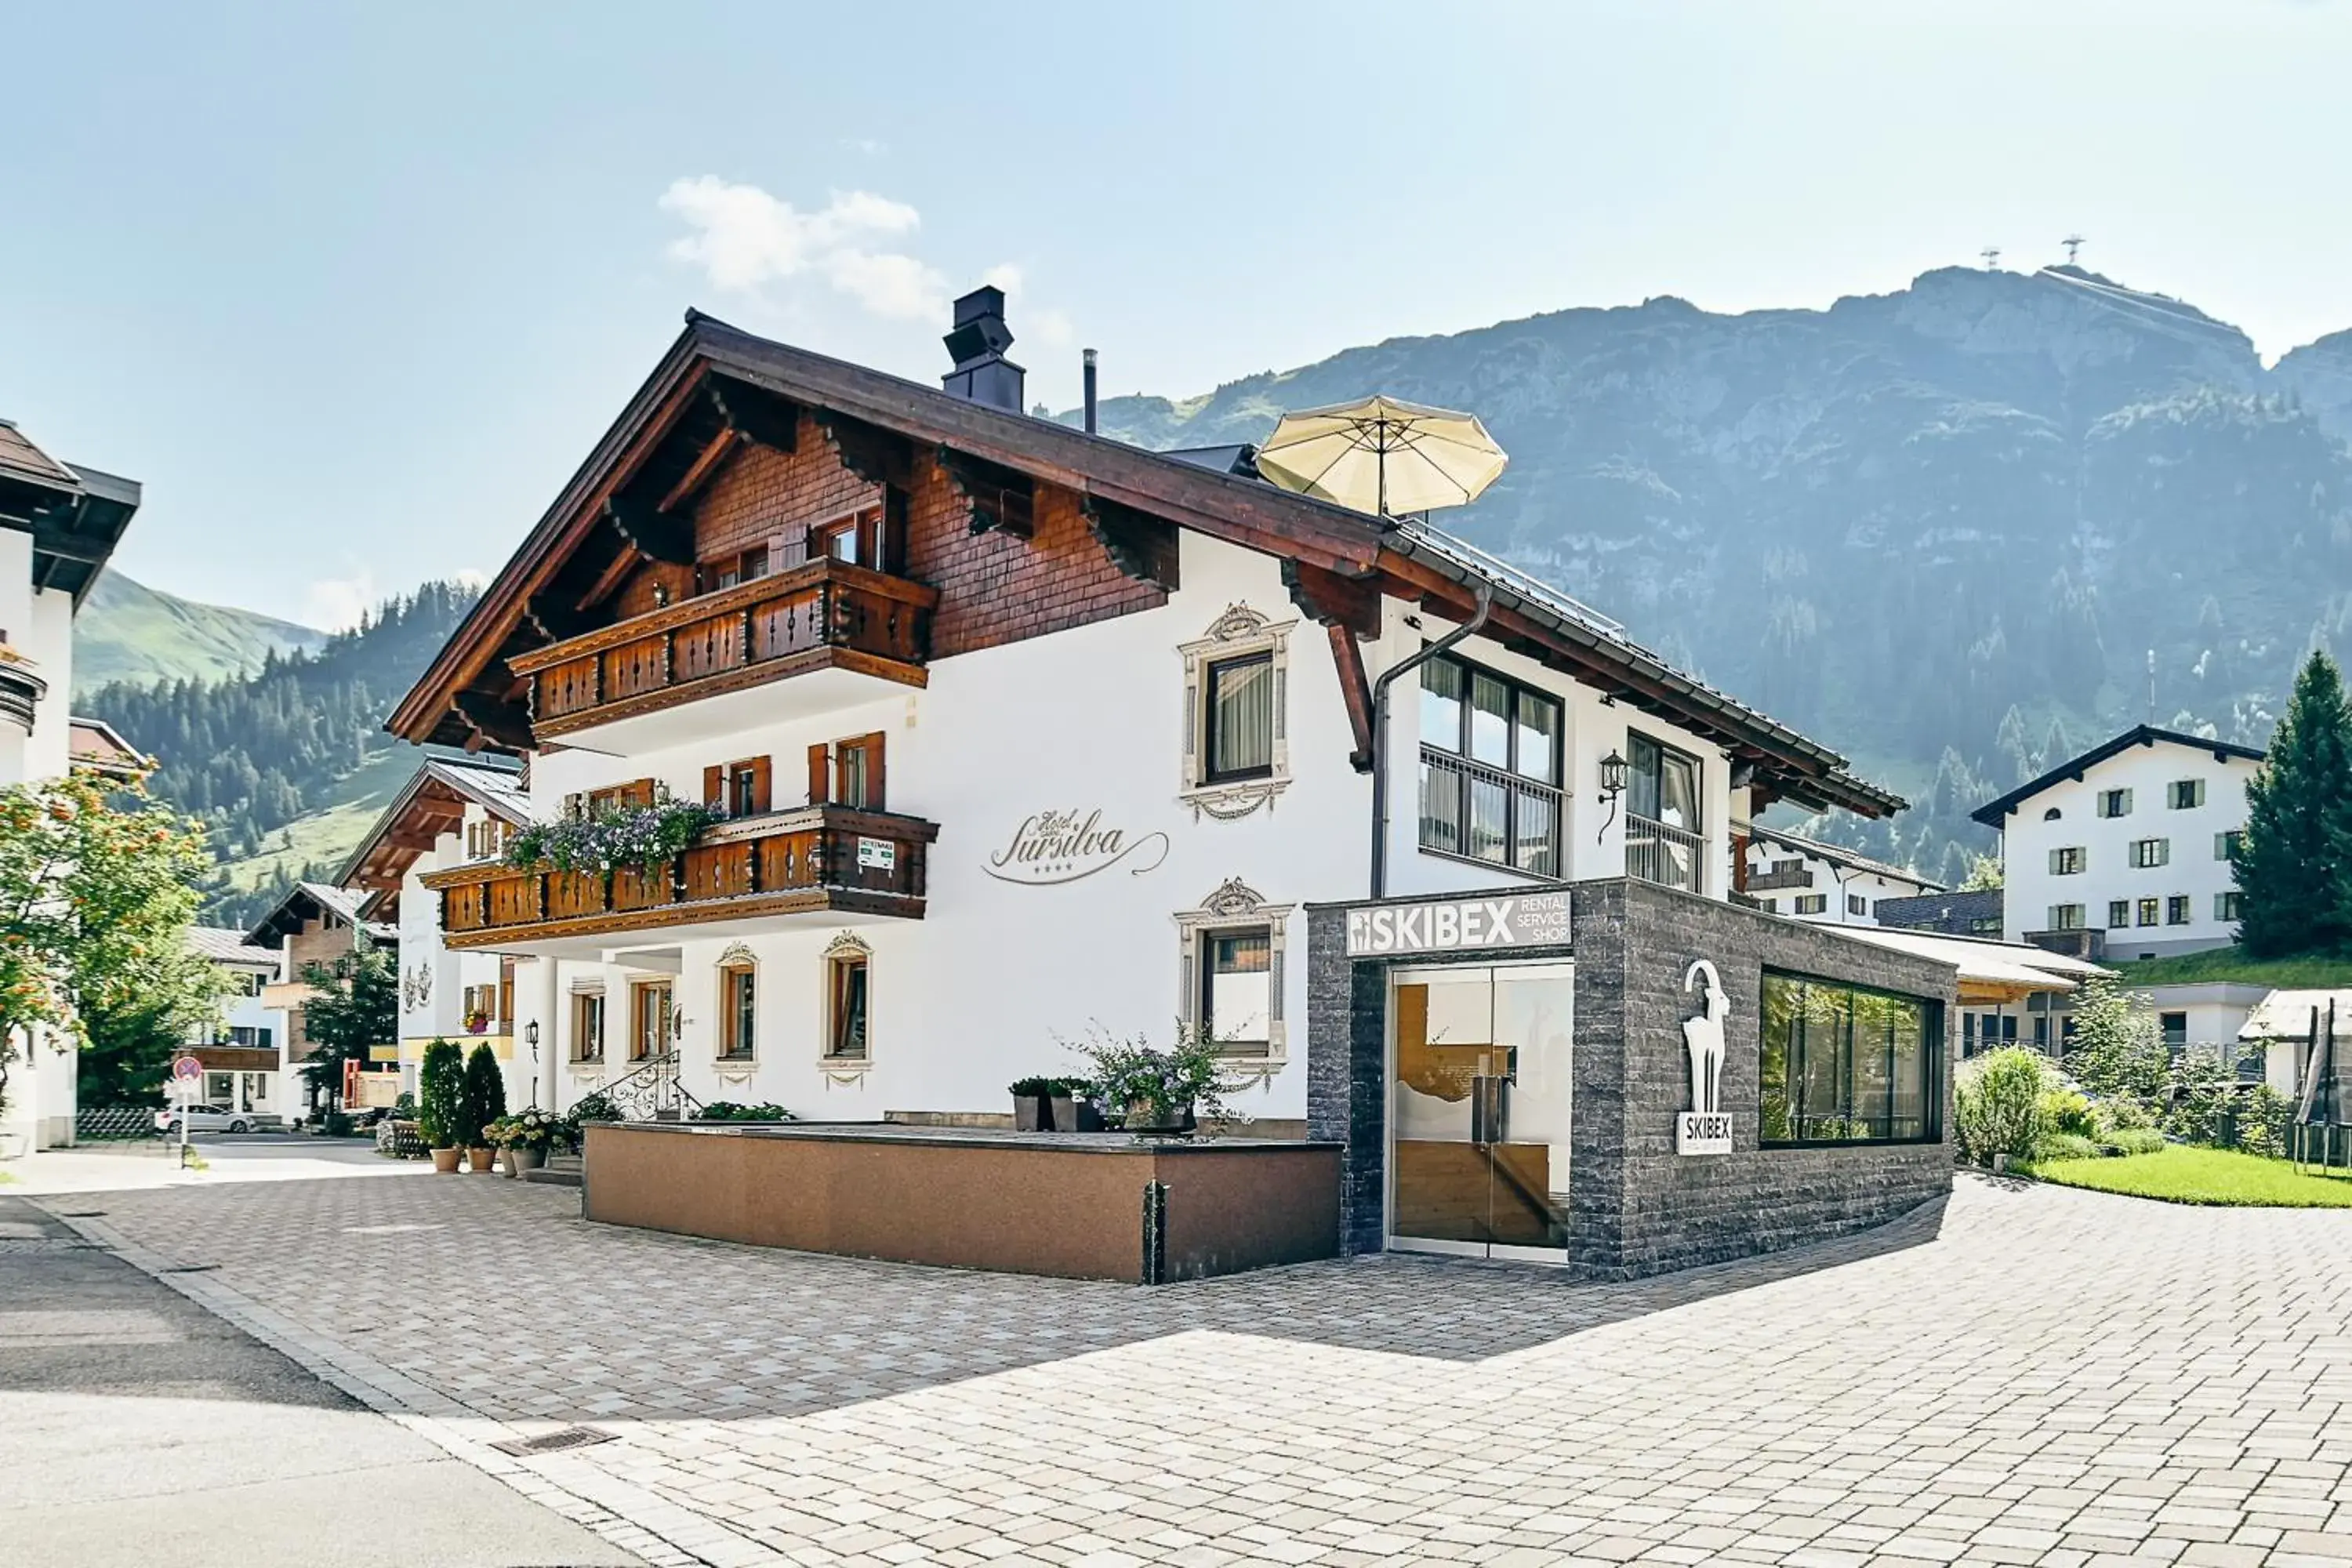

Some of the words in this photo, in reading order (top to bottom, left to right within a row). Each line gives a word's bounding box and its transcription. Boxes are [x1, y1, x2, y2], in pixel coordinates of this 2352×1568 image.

[1522, 896, 1568, 911] RENTAL
[1373, 900, 1515, 950] SKIBEX
[1517, 912, 1568, 927] SERVICE
[1533, 928, 1567, 941] SHOP
[1686, 1116, 1730, 1139] SKIBEX
